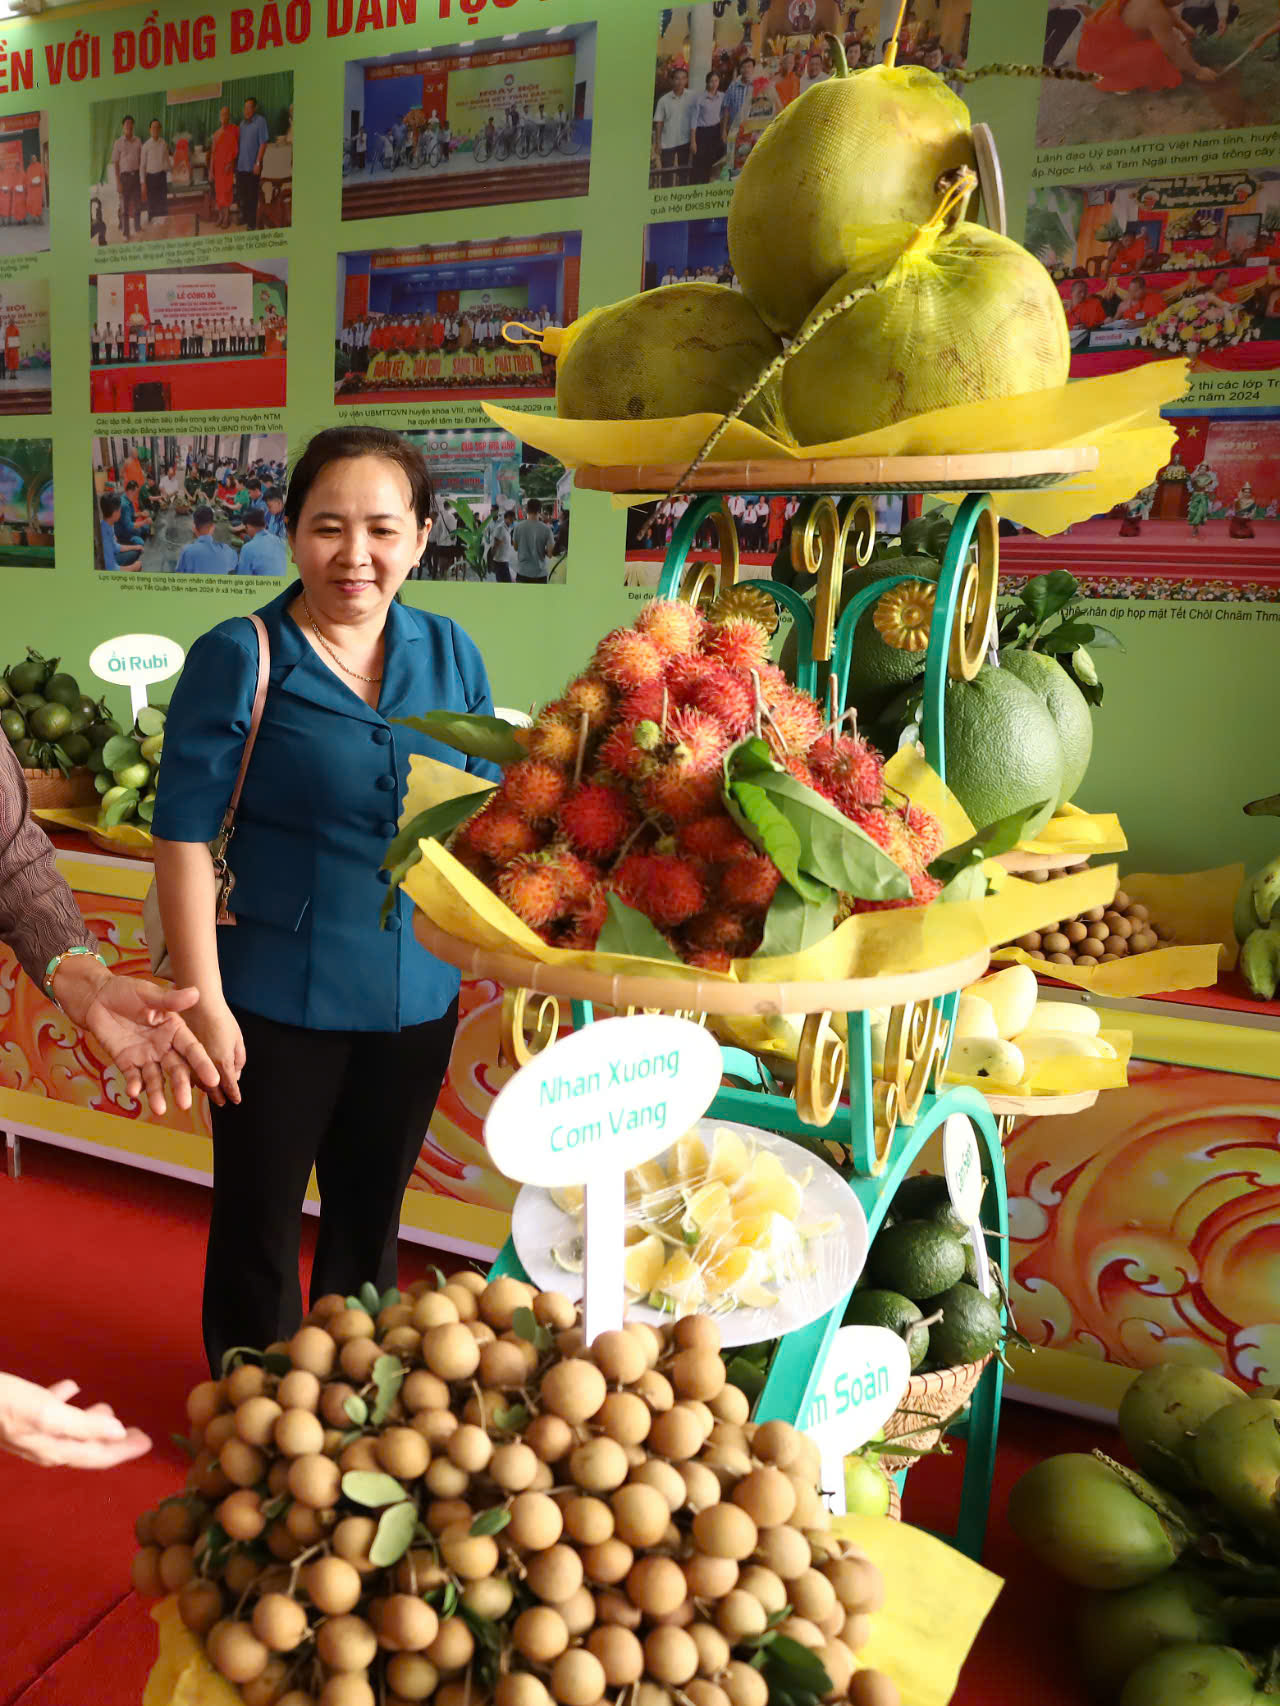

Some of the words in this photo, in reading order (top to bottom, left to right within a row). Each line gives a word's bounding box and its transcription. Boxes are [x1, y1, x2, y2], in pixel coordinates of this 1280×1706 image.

[45, 29, 101, 86] VỚI
[113, 9, 216, 74] ĐỒNG
[1106, 146, 1127, 156] ban
[1129, 142, 1165, 154] MTTQ
[1167, 140, 1189, 152] Việt
[1193, 139, 1220, 148] Nam
[1116, 160, 1138, 170] Tam
[1170, 154, 1198, 165] tham
[1201, 152, 1218, 163] gia
[671, 190, 702, 202] Nguyễn
[1199, 379, 1214, 390] thi
[1217, 379, 1240, 390] các
[1243, 378, 1263, 390] lớp
[1199, 391, 1225, 402] năm
[1229, 391, 1260, 402] 2024
[263, 413, 281, 421] NTM
[1110, 606, 1124, 618] dịp
[1127, 608, 1145, 620] họp
[1149, 609, 1167, 620] mặt
[1170, 606, 1186, 619] Tết
[1189, 608, 1213, 620] Chôl
[130, 654, 169, 671] Rubi
[834, 1361, 889, 1414] Soàn
